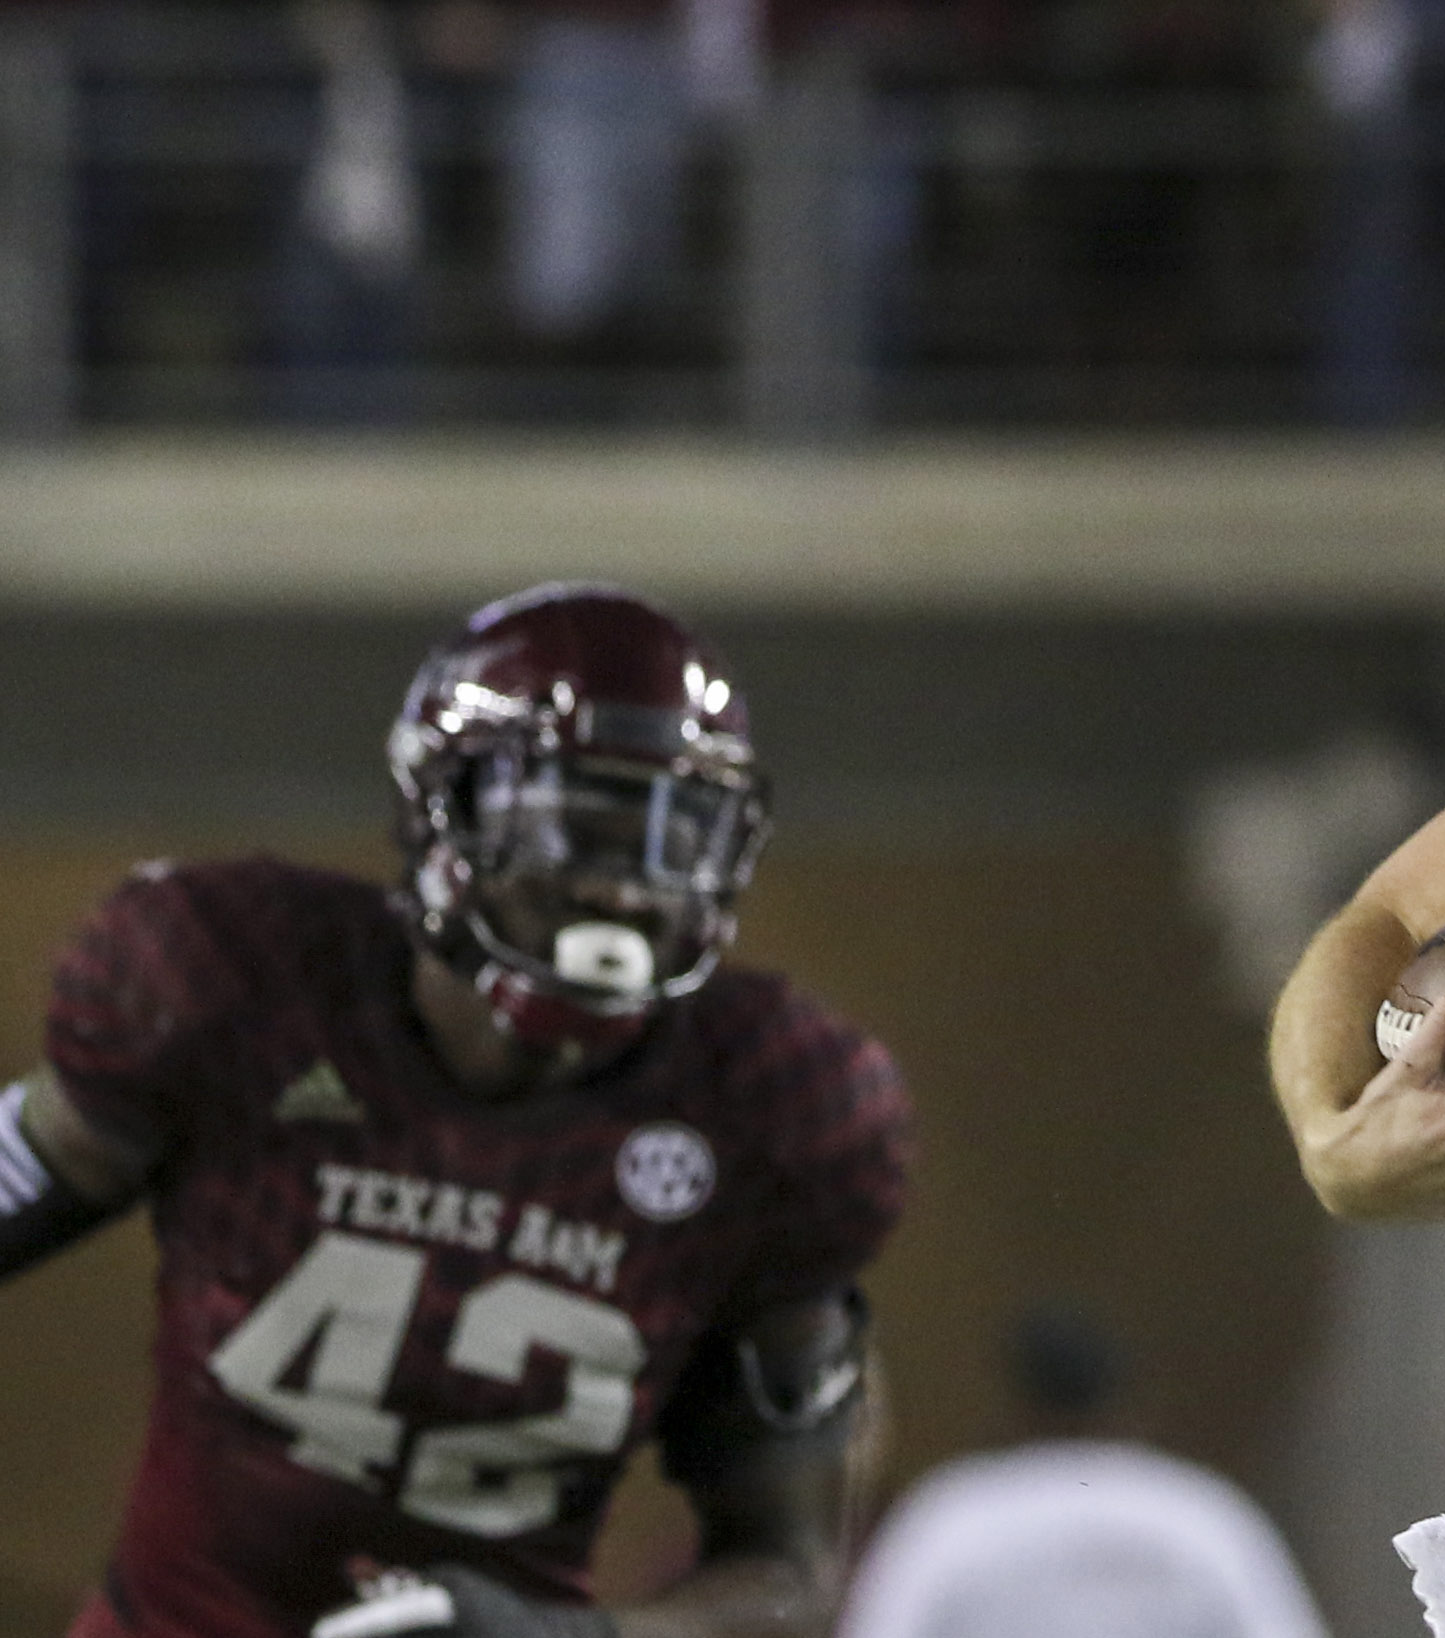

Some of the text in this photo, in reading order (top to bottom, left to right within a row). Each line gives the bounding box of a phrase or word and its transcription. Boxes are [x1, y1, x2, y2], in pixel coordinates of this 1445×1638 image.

[315, 1162, 628, 1292] TEXAS A&M
[207, 1229, 648, 1538] 42
